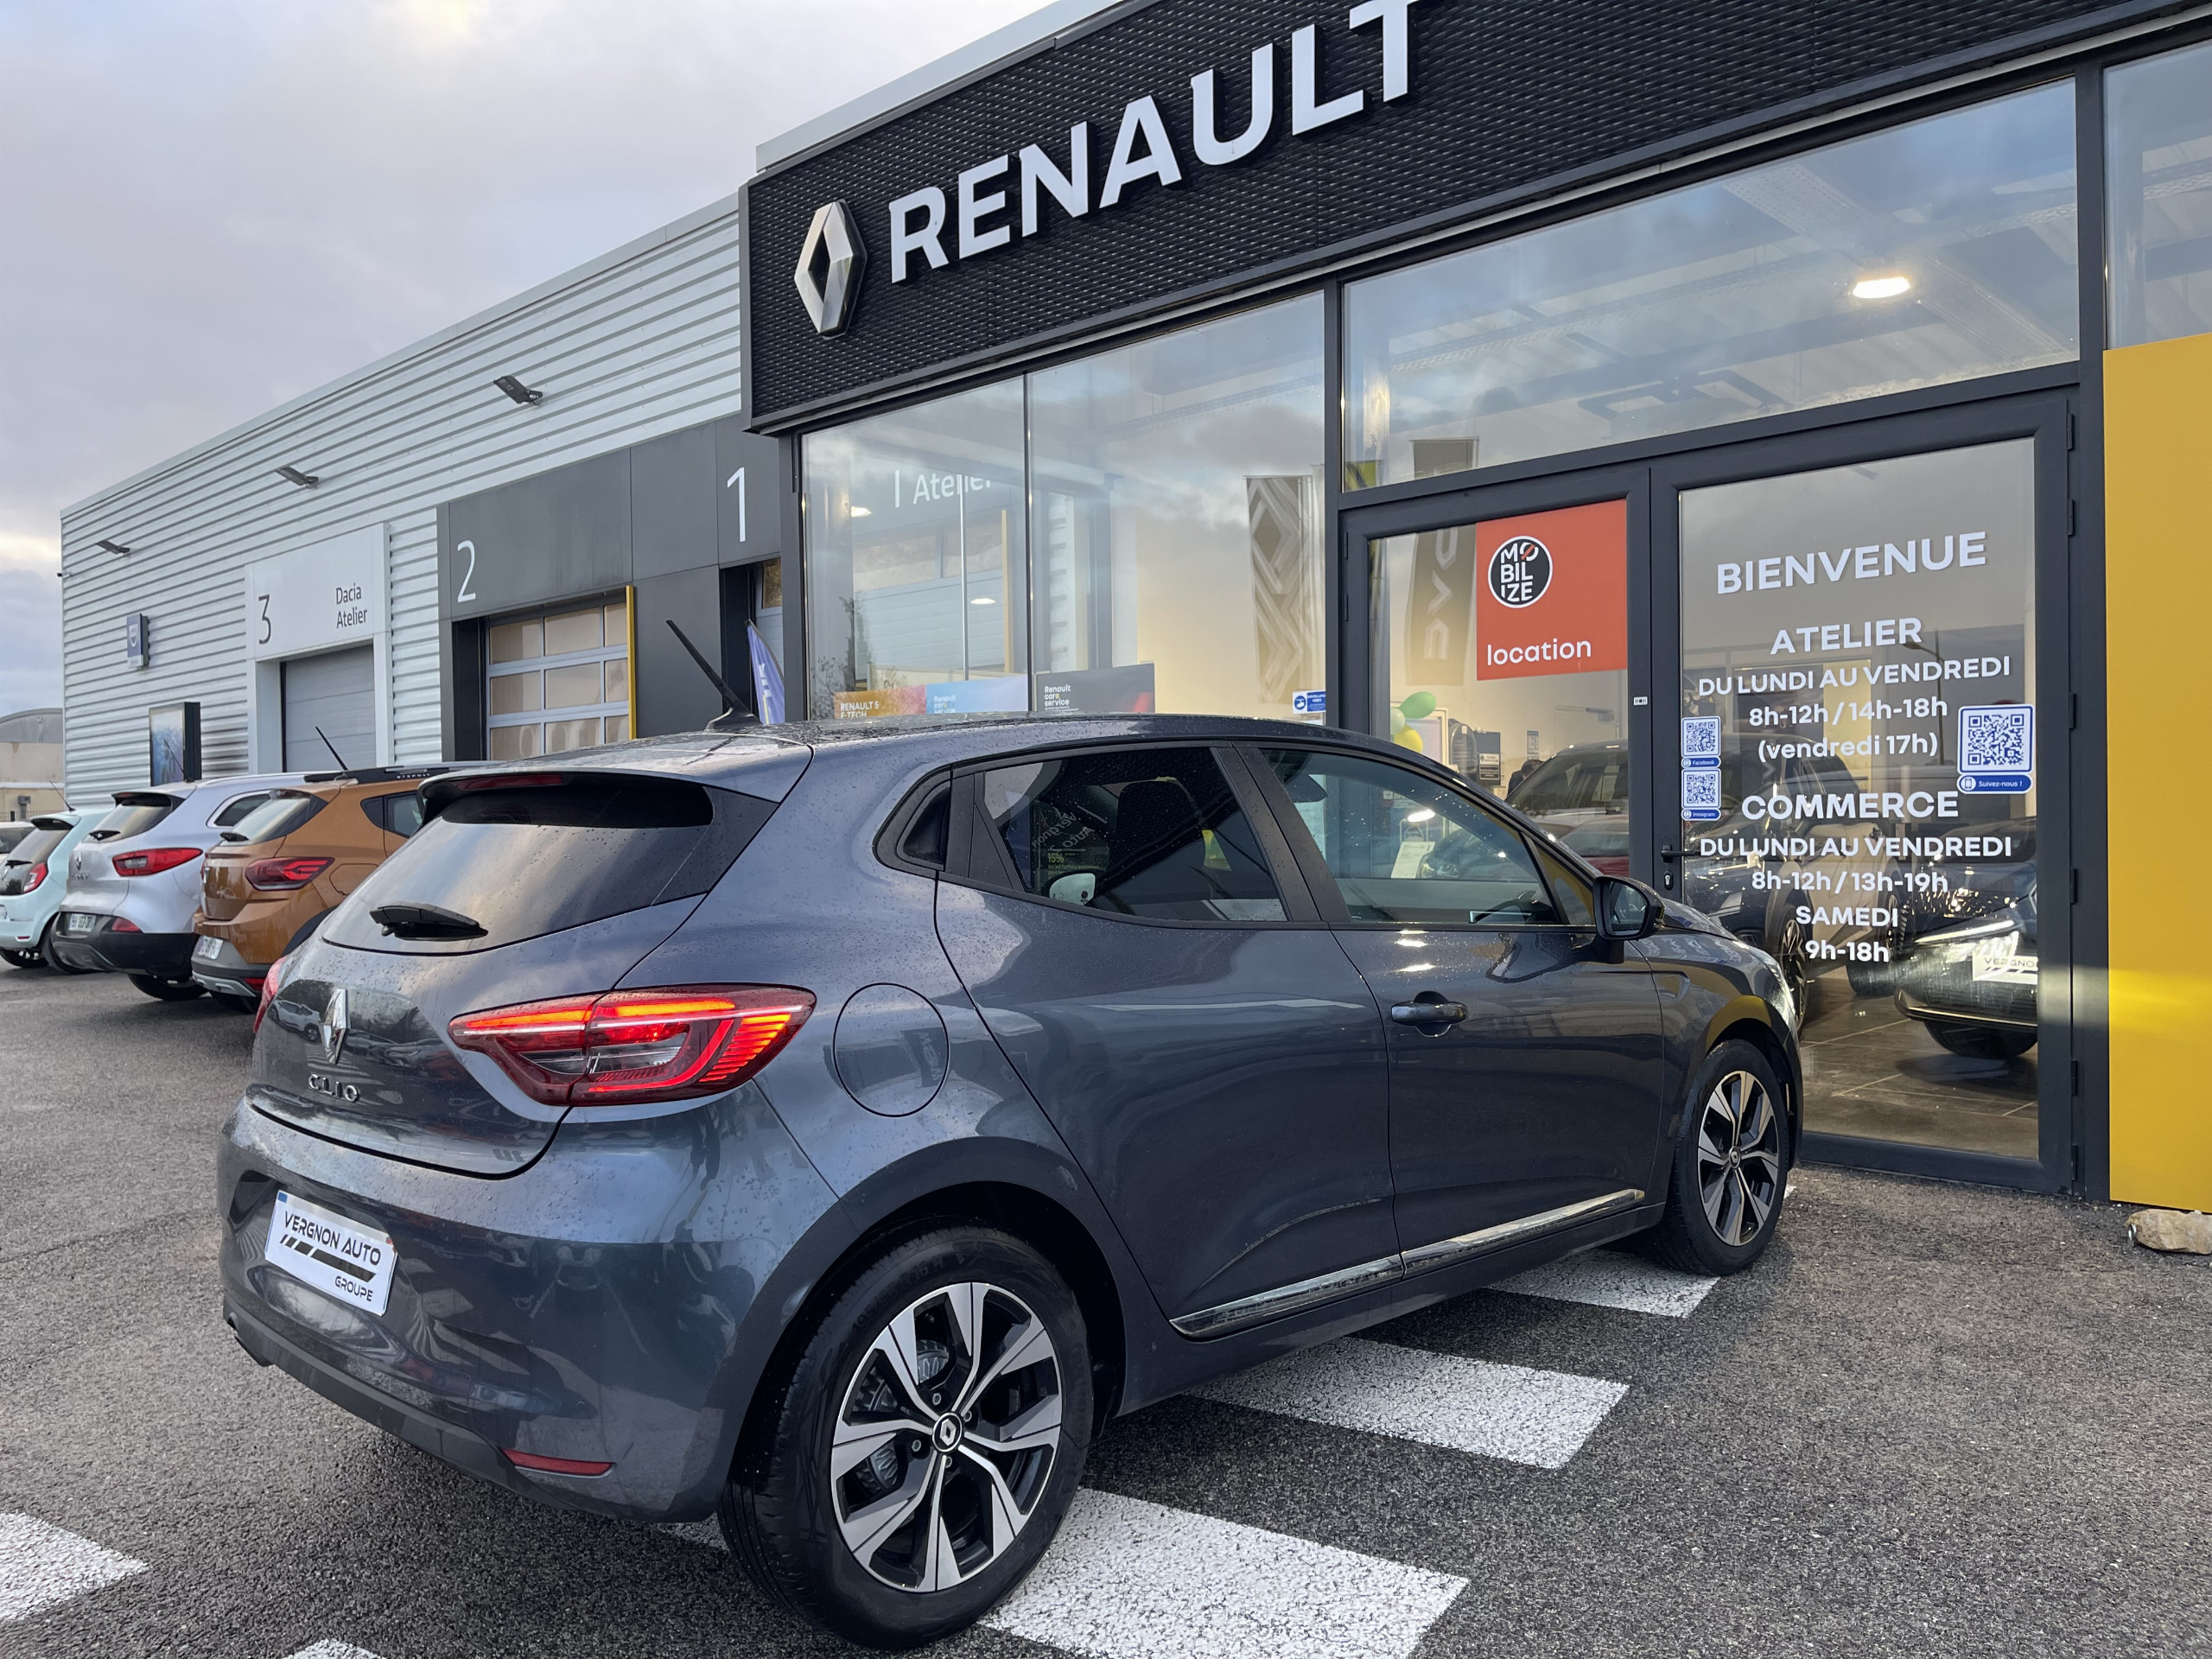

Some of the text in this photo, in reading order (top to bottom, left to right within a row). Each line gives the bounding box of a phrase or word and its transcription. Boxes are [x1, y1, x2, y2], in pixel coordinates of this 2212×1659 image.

[889, 0, 1415, 283] RENAULT
[727, 467, 747, 543] 1
[456, 539, 476, 603] 2
[1717, 530, 1987, 595] BIENVENUE
[335, 582, 362, 605] Dacia
[258, 594, 271, 645] 3
[336, 607, 368, 629] Atelier
[1770, 617, 1922, 656] ATELIER
[1487, 638, 1592, 666] location
[1044, 683, 1071, 693] Renault
[1699, 656, 2011, 696] DU LUNDI AU VENDREDI
[840, 701, 880, 711] RENAULT 5
[1758, 732, 1939, 763] (vendredi 17h)
[1741, 791, 1960, 821] COMMERCE
[1700, 836, 2012, 857] DU LUNDI AU VENDREDI
[1796, 905, 1898, 928] SAMEDI
[1804, 939, 1890, 963] 9h-18h
[308, 1073, 360, 1103] CLIO
[284, 1211, 381, 1266] VERGNON AUTO
[334, 1275, 373, 1301] GROUPE
